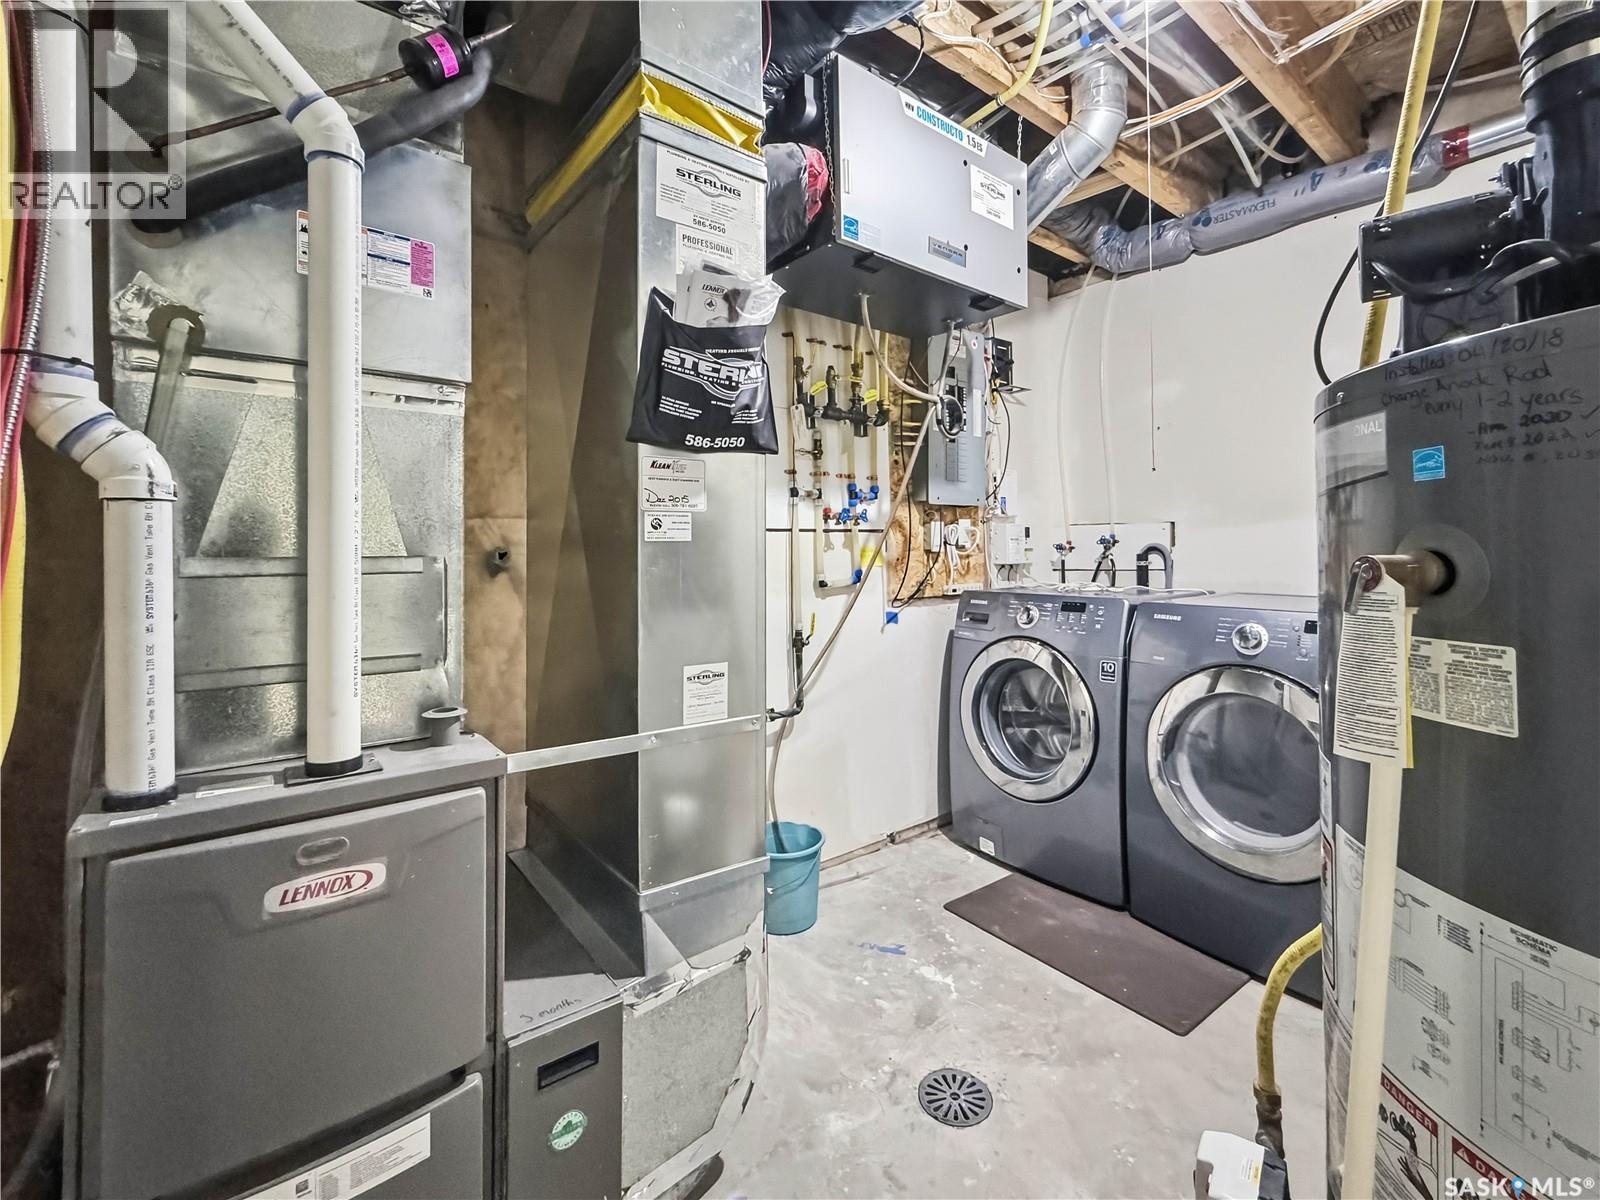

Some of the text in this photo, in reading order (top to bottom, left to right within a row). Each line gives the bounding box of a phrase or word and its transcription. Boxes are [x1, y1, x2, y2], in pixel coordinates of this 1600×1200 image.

[915, 105, 964, 142] CONSTRUCTO
[675, 167, 742, 199] STERLING
[1212, 198, 1277, 225] FLEXMASTER
[682, 233, 734, 256] PROFESSIONAL
[1503, 358, 1553, 385] Rod
[1520, 388, 1584, 412] years
[684, 433, 746, 449] 586-5050
[650, 459, 672, 470] KLEAN
[644, 487, 690, 504] Dec 2015
[1153, 613, 1182, 621] SAMSUNG
[686, 672, 725, 682] STERLING
[1102, 662, 1115, 672] 10
[279, 873, 356, 906] LENNOX
[1509, 927, 1559, 953] SCHEMATIC
[538, 998, 583, 1018] months
[1383, 1078, 1433, 1131] DANGER
